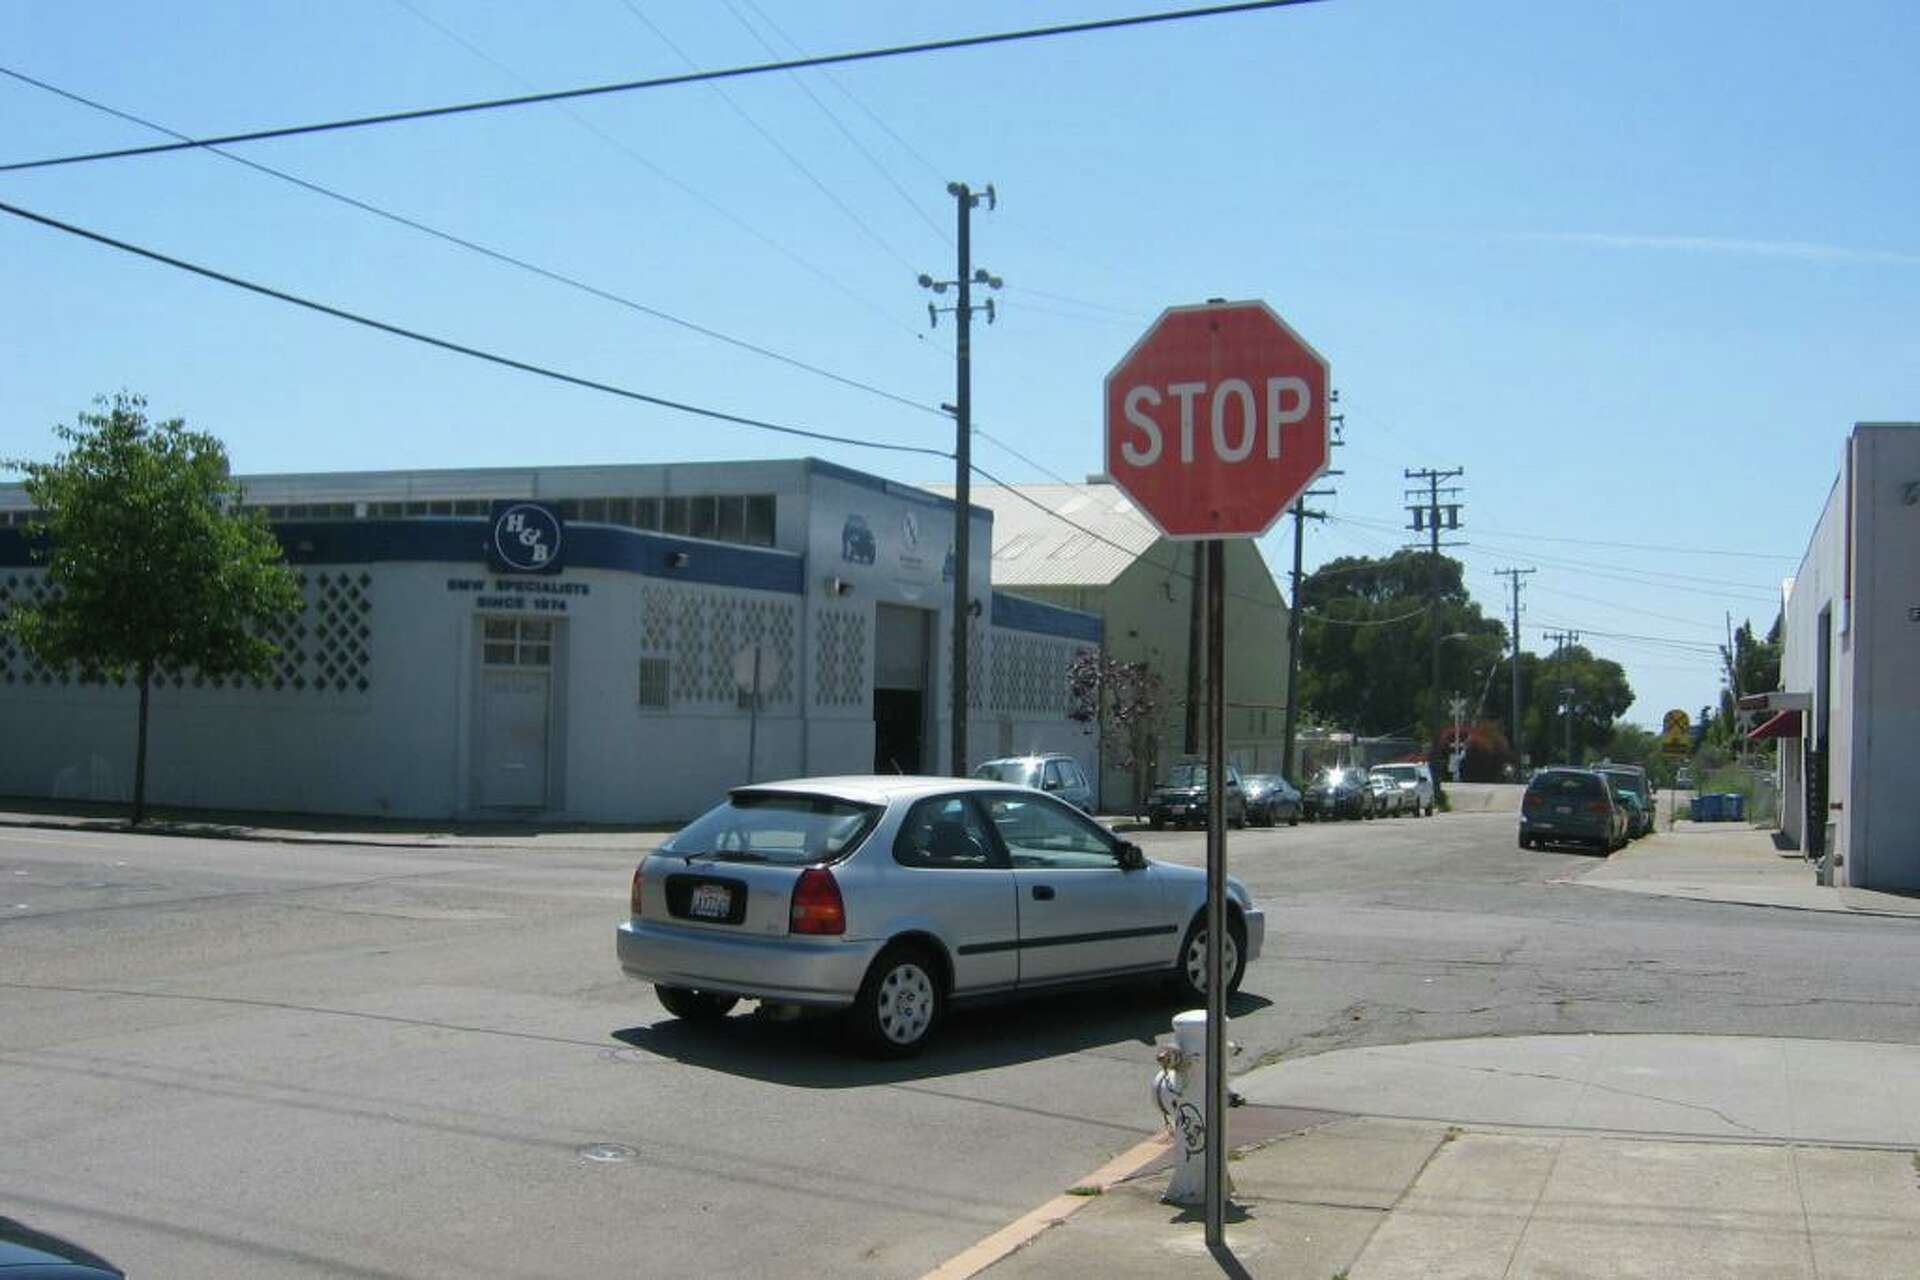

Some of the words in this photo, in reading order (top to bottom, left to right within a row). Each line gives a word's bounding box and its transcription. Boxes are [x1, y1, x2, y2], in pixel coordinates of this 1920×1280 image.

[1121, 376, 1311, 467] STOP
[495, 580, 590, 595] SPECIALISTS
[477, 597, 524, 609] SINCE
